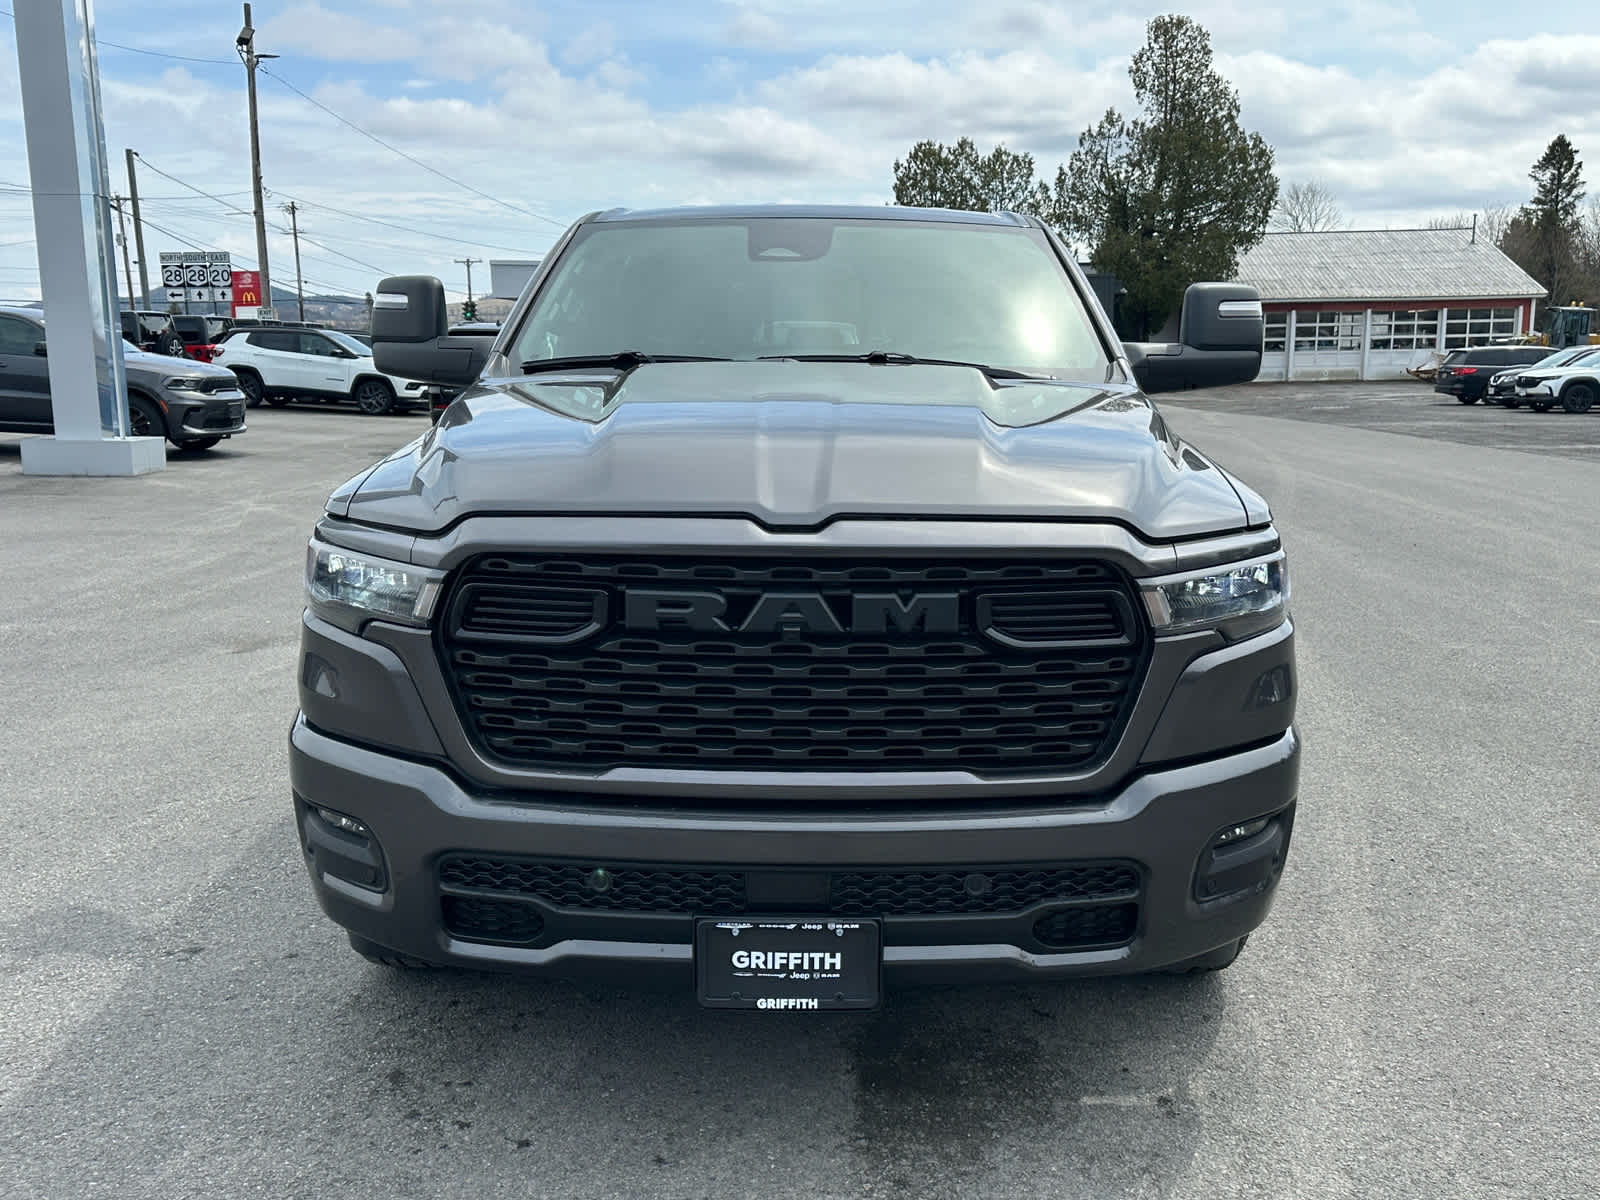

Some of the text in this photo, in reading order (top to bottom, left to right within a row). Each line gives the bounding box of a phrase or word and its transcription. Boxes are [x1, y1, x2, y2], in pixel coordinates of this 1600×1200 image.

[210, 254, 227, 262] EAST
[164, 269, 183, 282] 28
[188, 269, 206, 282] 28
[211, 269, 230, 282] 20
[625, 588, 960, 633] RAM
[801, 923, 823, 931] Jeep
[731, 950, 842, 970] GRIFFITH
[789, 971, 810, 980] Jeep
[756, 998, 819, 1010] GRIFFITH
